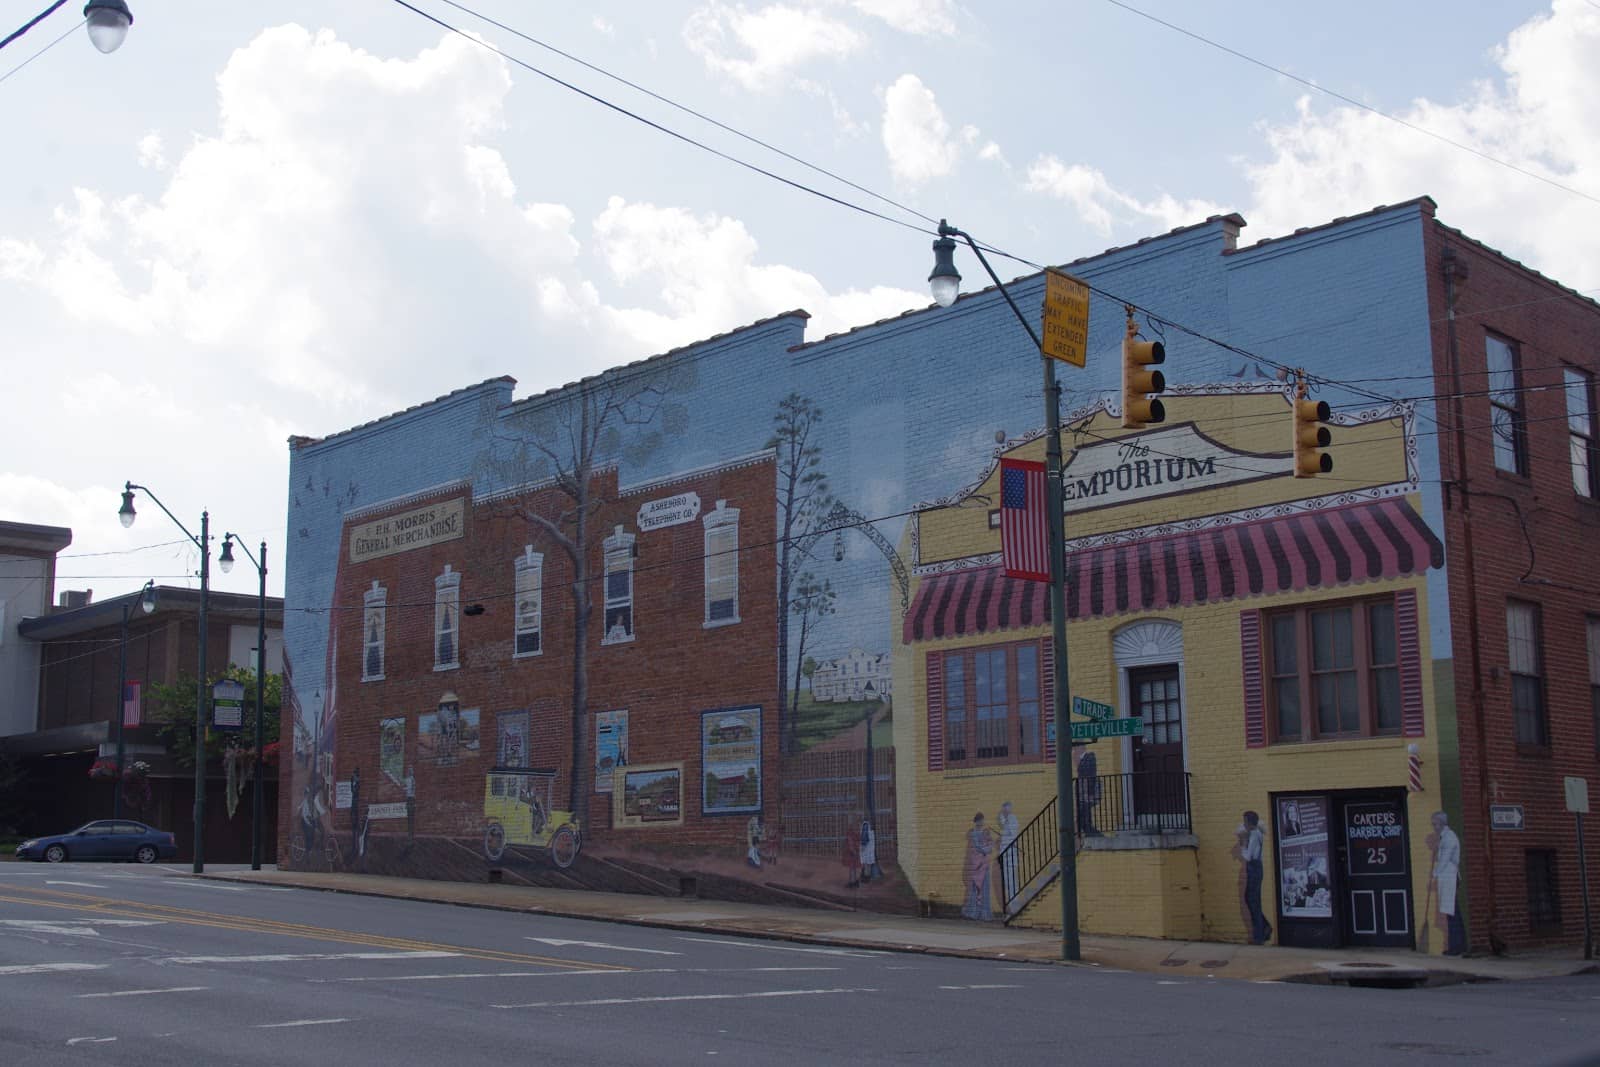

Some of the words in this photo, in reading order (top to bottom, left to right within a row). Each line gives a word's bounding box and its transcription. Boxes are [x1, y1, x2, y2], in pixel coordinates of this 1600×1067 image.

[1054, 291, 1083, 313] TRAFFIC
[1047, 303, 1062, 320] MAY
[1067, 313, 1086, 330] HAVE
[1047, 321, 1084, 345] EXTENDED
[1053, 340, 1077, 359] GREEN
[1118, 438, 1150, 463] The
[1063, 456, 1217, 501] EMPORIUM
[394, 510, 436, 532] MORRIS
[355, 537, 389, 555] GENERAL
[393, 512, 459, 546] MERCHANDISE
[1082, 700, 1107, 721] TRADE
[1070, 721, 1128, 737] YETTEVILLE
[1349, 827, 1385, 840] BARBER
[1367, 847, 1388, 865] 25
